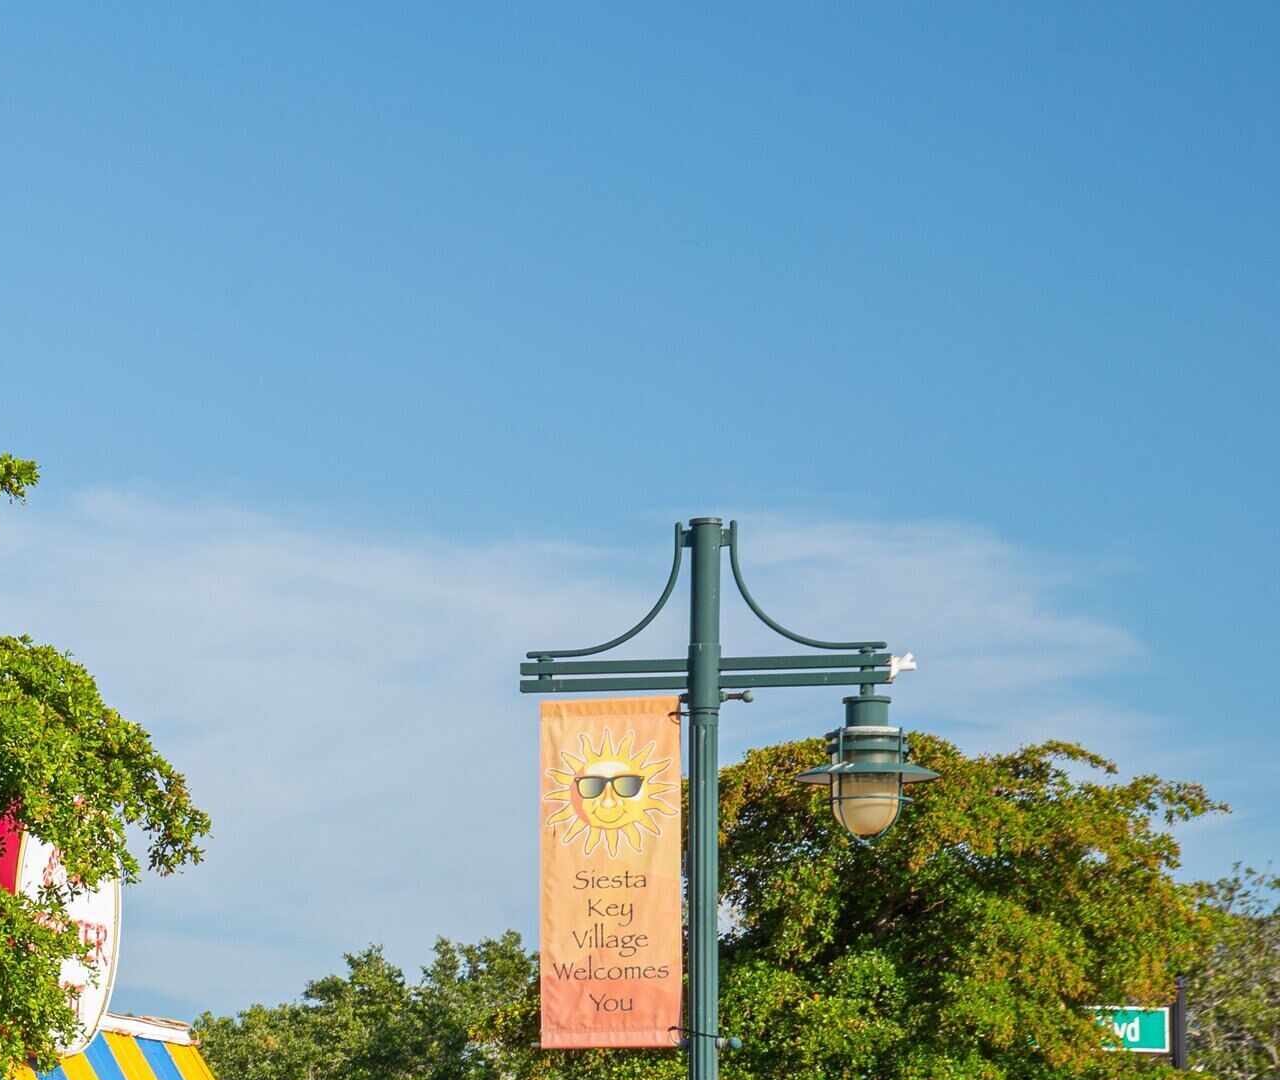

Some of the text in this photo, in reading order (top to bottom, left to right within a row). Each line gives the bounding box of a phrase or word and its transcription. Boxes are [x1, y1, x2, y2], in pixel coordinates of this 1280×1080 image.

[573, 870, 647, 889] Siesta
[587, 898, 633, 927] Key
[572, 924, 649, 957] Village
[553, 955, 670, 981] Welcomes
[589, 994, 633, 1012] You
